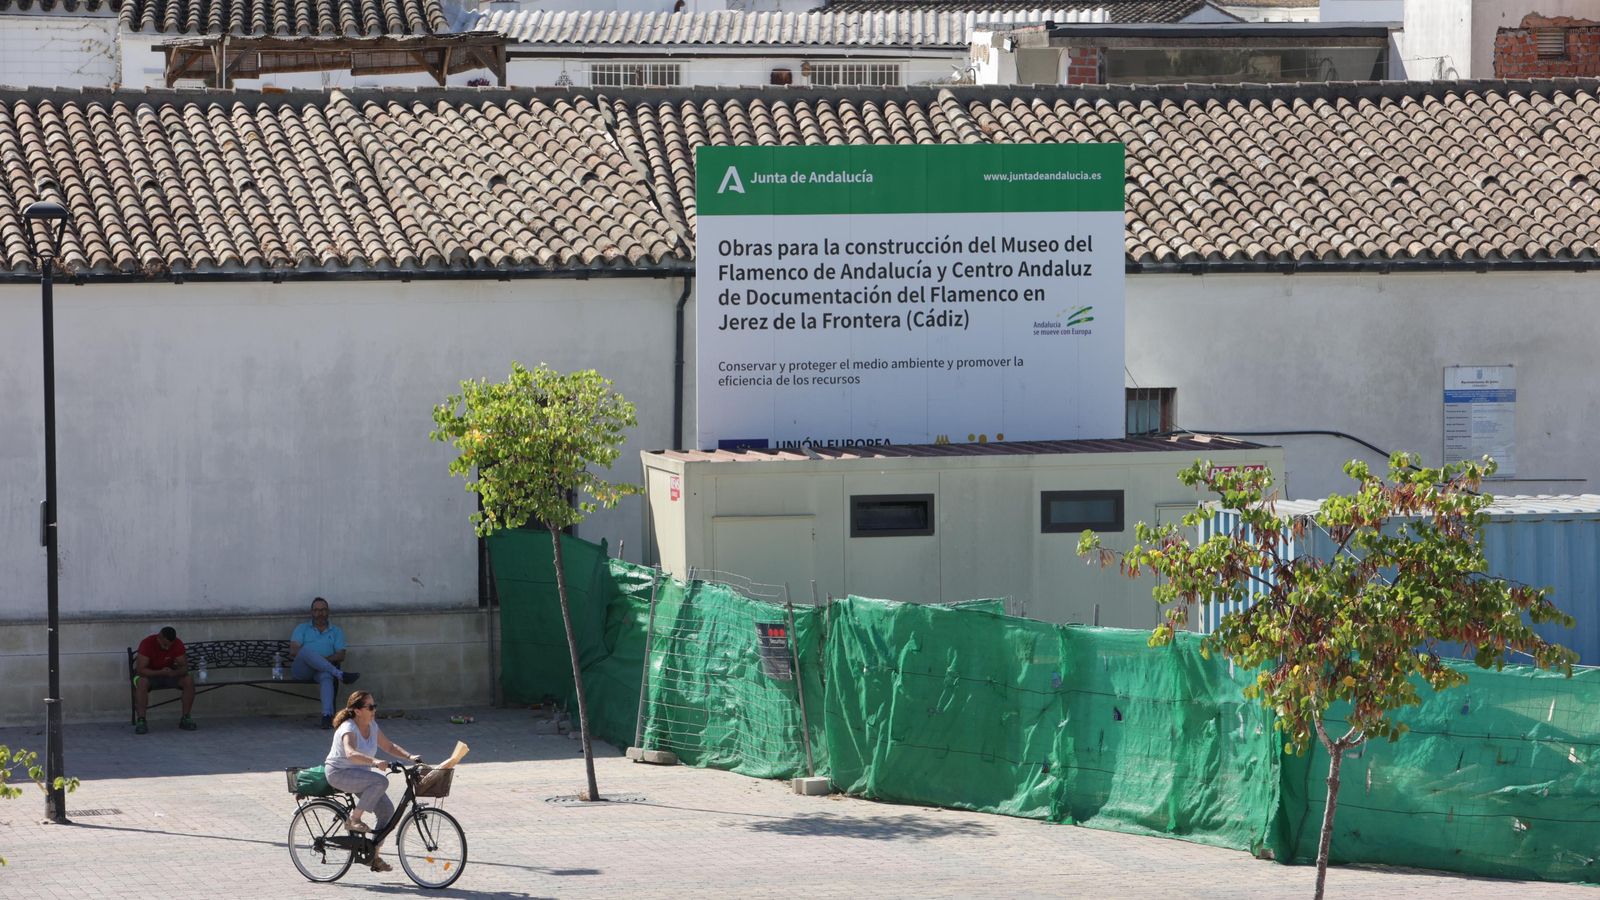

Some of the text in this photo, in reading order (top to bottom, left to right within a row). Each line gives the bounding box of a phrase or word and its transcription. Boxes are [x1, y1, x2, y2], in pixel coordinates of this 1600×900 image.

[751, 170, 873, 183] Junta de Andalucía
[984, 171, 1101, 182] www.juntadeandalucia.es
[719, 235, 1092, 260] Obras para la construcción del Museo del
[719, 259, 1092, 282] Flamenco de Andalucía y Centro Andaluz
[719, 285, 1044, 305] de Documentación del Flamenco en
[719, 310, 969, 331] Jerez de la Frontera (Cádiz)
[1071, 328, 1092, 337] Europa
[719, 356, 1023, 373] Conservar y proteger el medio ambiente y promover la
[719, 375, 860, 386] eficiencia de los recursos
